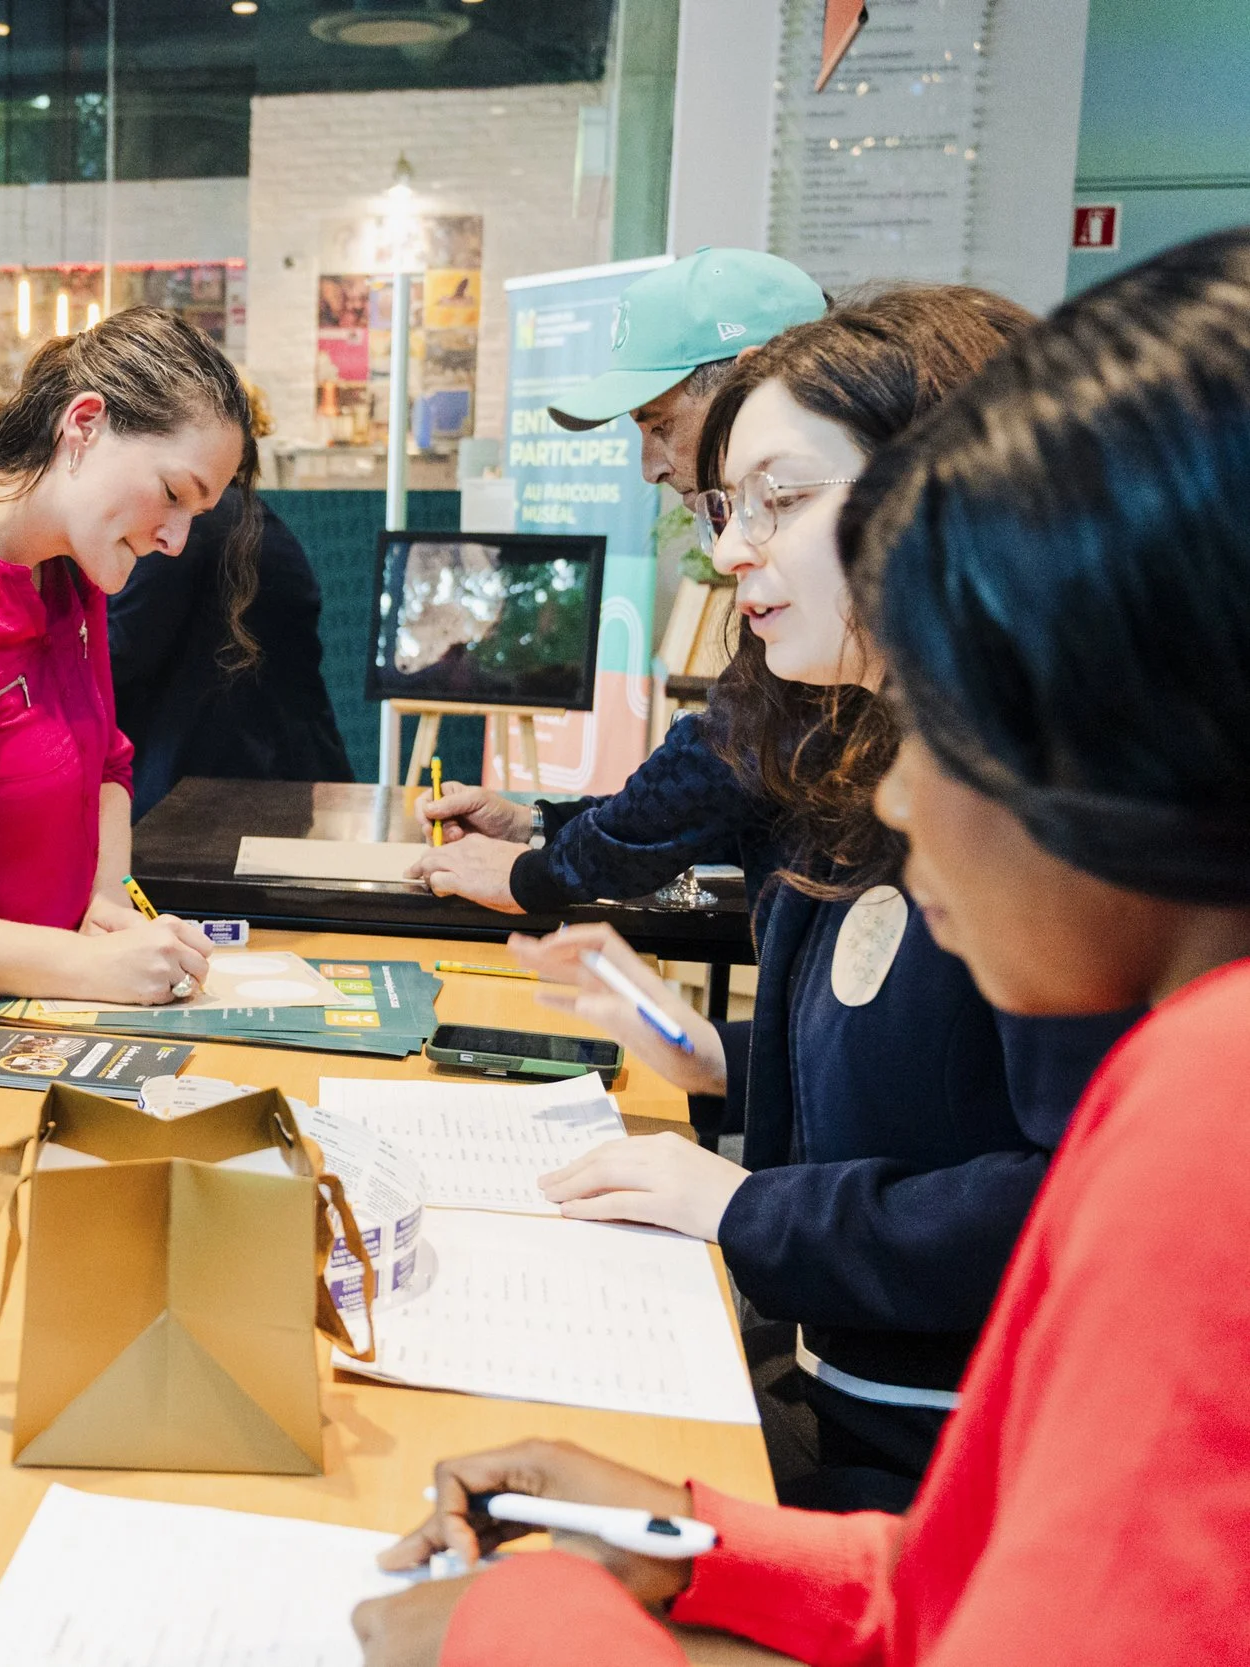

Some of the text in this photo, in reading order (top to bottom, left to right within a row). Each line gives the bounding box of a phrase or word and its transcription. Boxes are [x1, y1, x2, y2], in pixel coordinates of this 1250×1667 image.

[509, 439, 628, 467] PARTICIPEZ
[522, 482, 621, 504] AU PARCOURS
